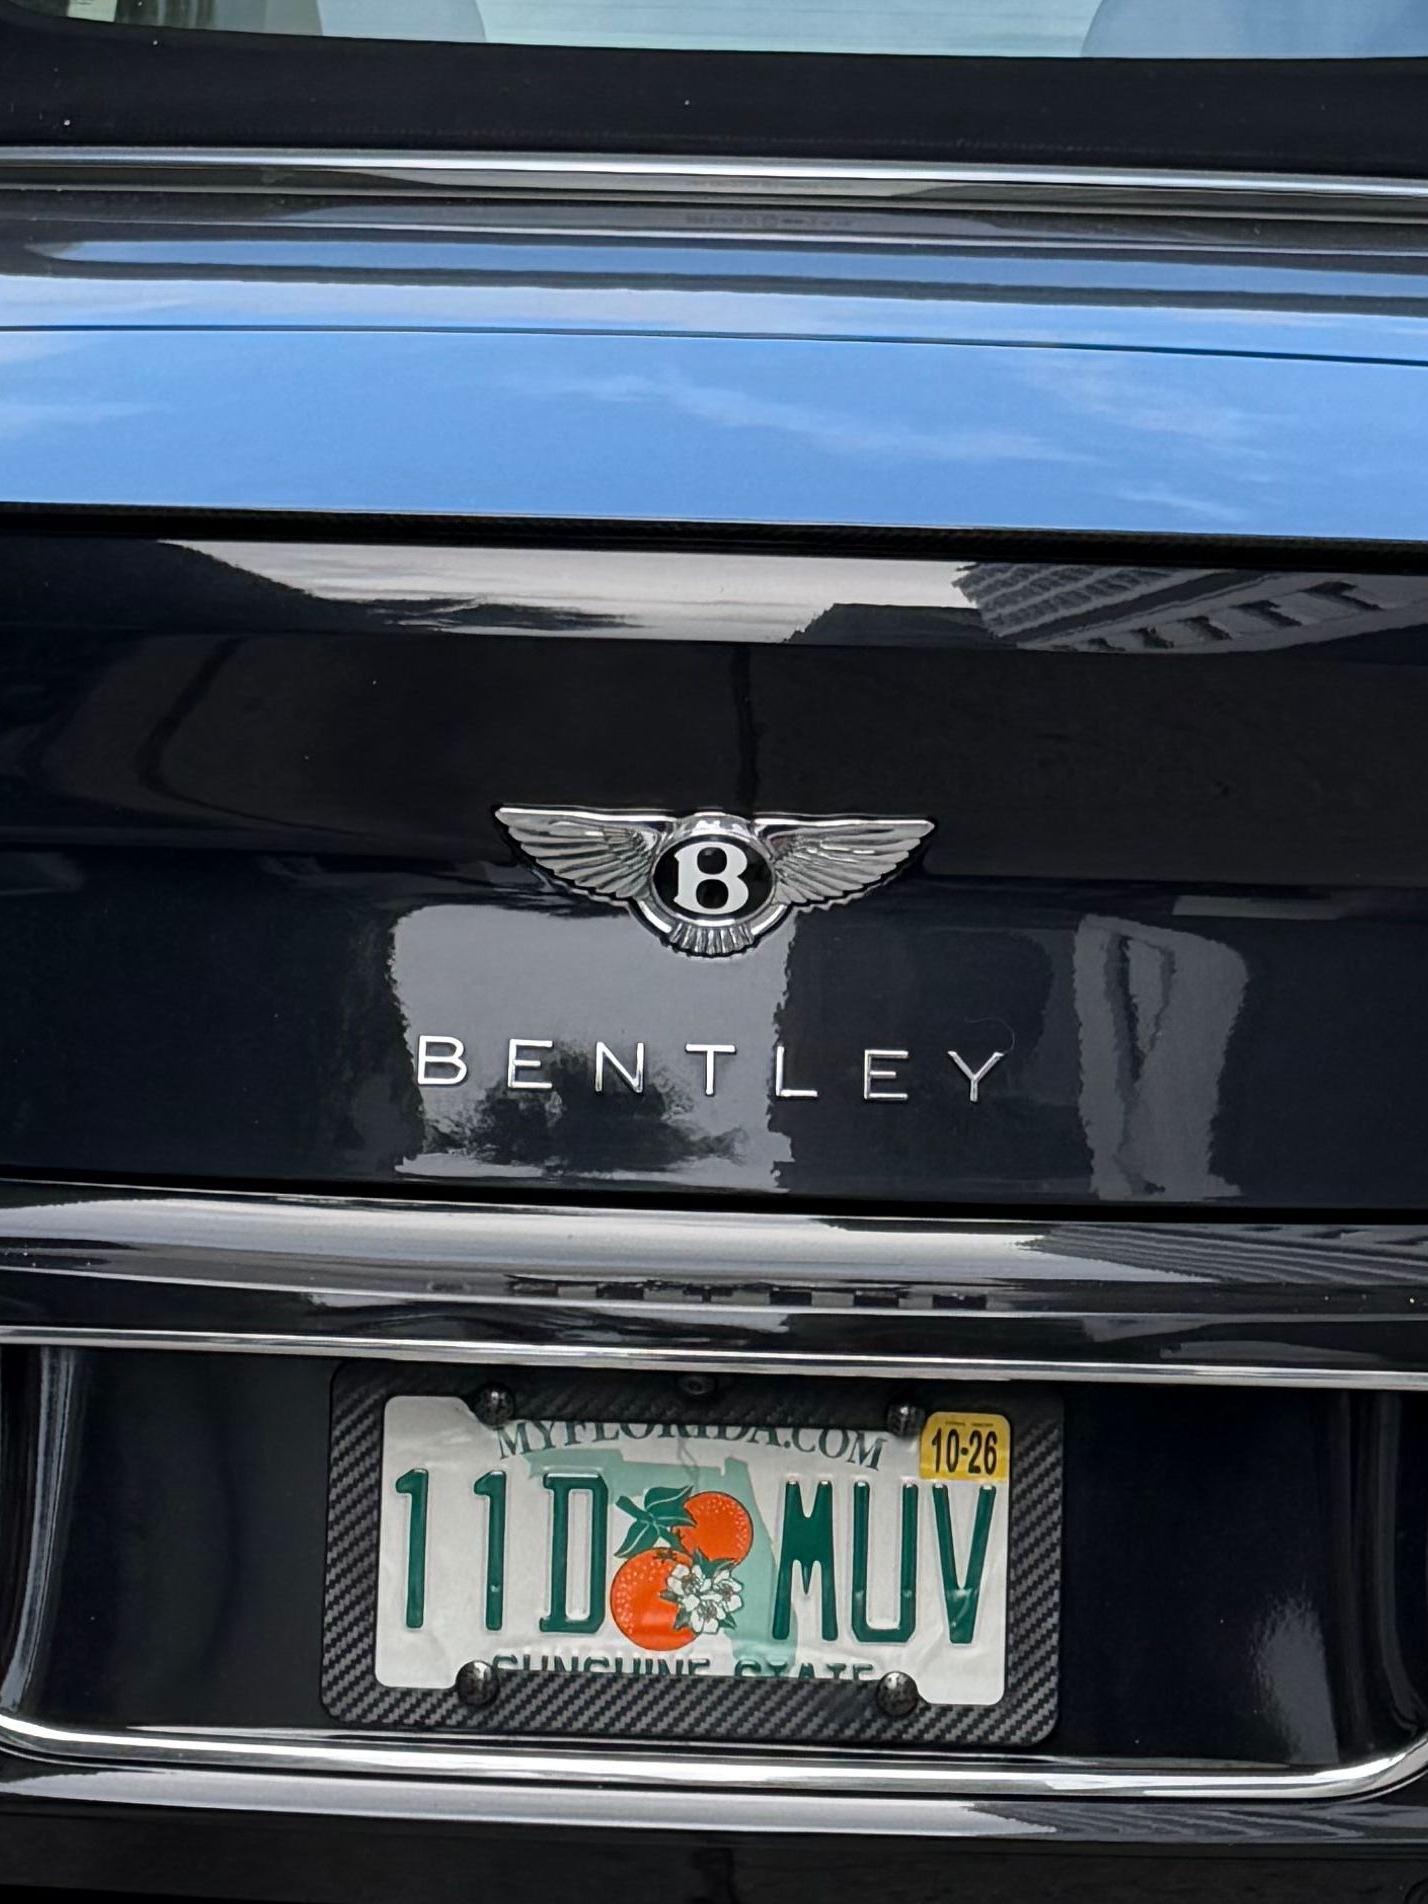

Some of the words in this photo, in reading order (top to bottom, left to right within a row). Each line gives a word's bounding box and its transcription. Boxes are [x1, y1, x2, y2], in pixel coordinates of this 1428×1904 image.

[674, 842, 751, 915] B
[416, 1034, 1006, 1104] BENTLEY
[394, 1468, 611, 1635] 11D
[772, 1480, 997, 1645] MUV
